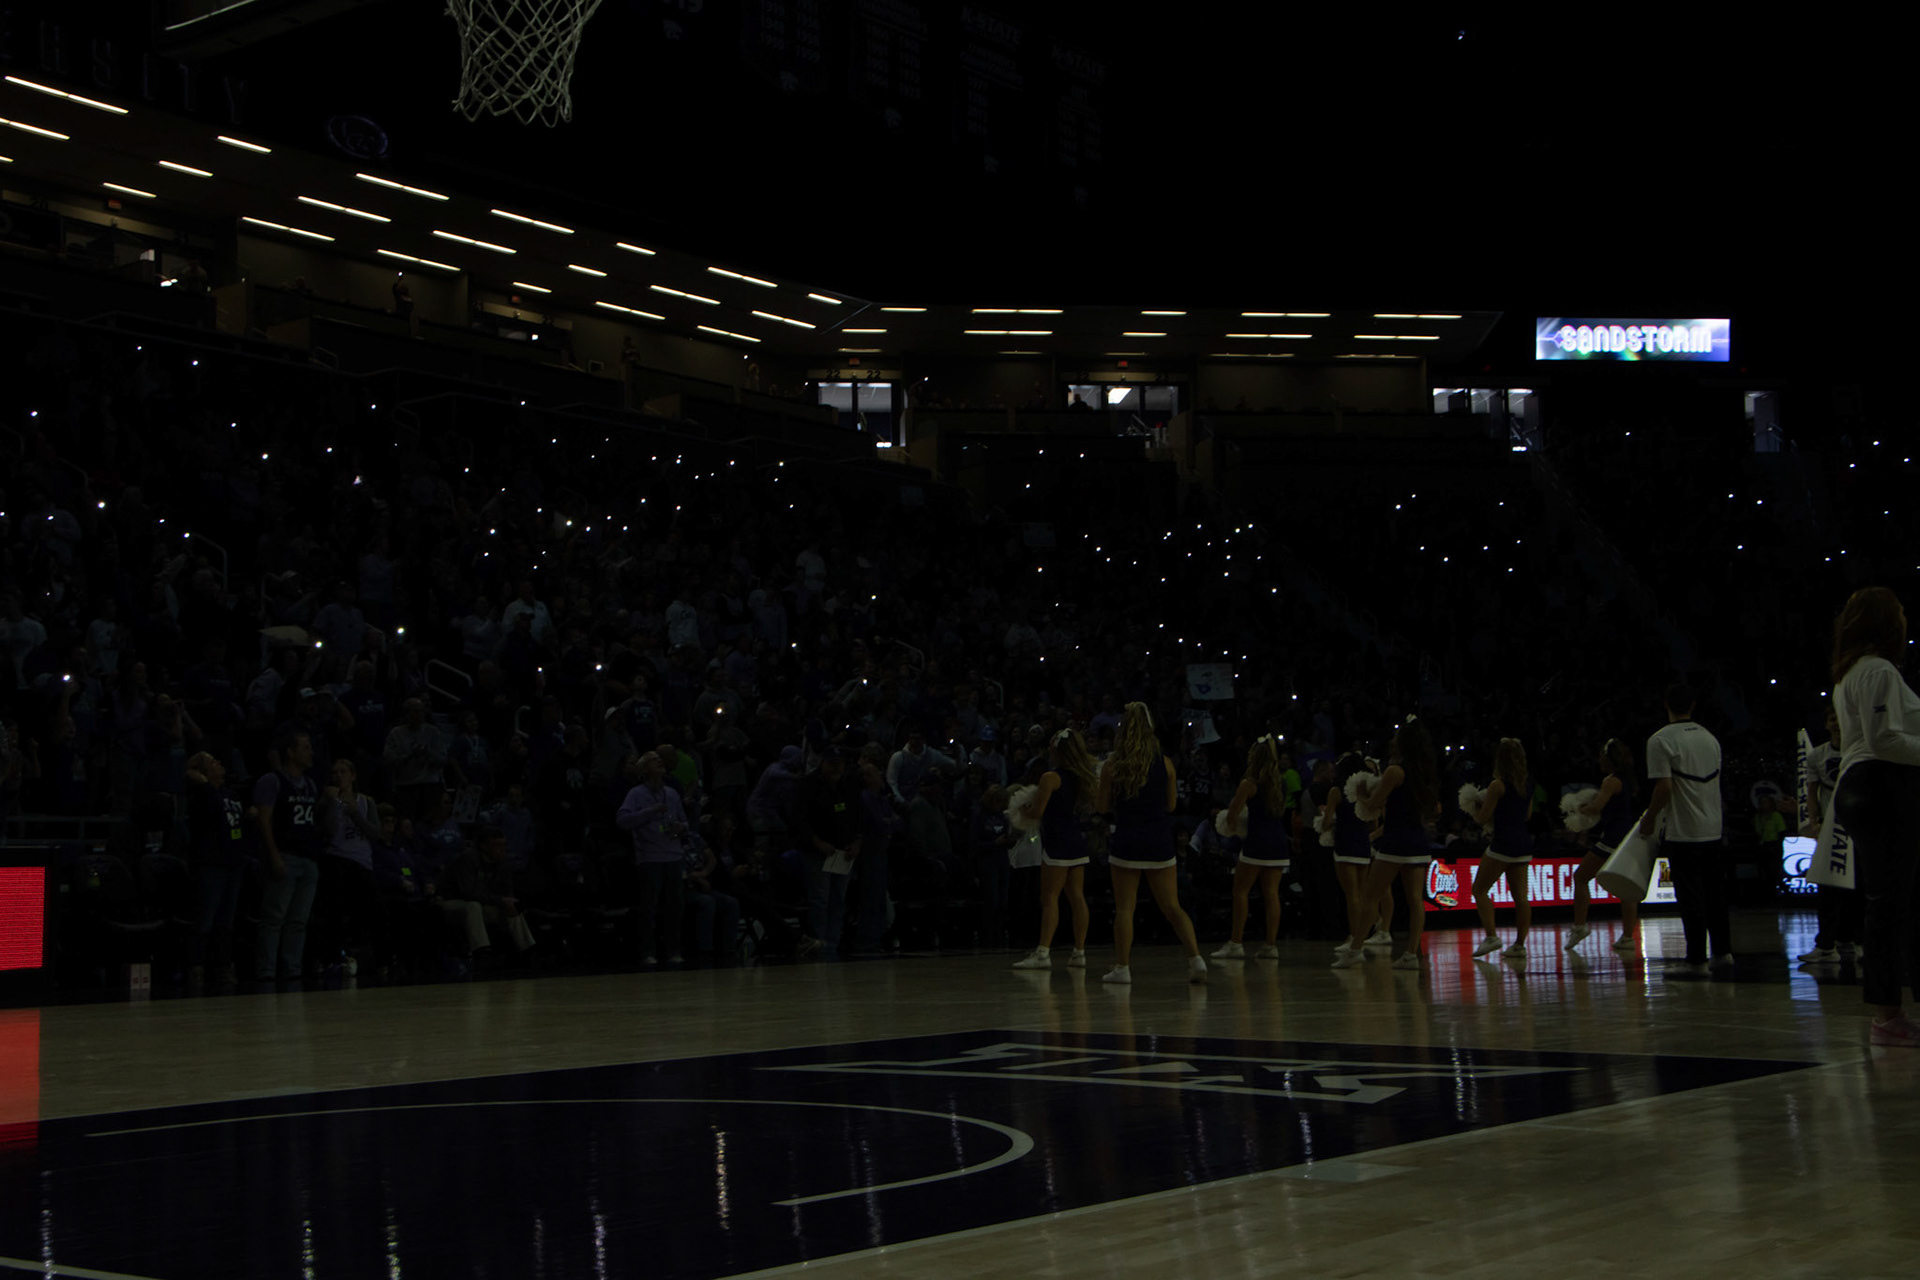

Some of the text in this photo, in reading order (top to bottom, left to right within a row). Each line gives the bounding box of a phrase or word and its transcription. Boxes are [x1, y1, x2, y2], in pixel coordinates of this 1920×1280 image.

[1560, 324, 1712, 354] SANDSTORM
[293, 804, 314, 825] 24
[1830, 819, 1849, 876] TATE
